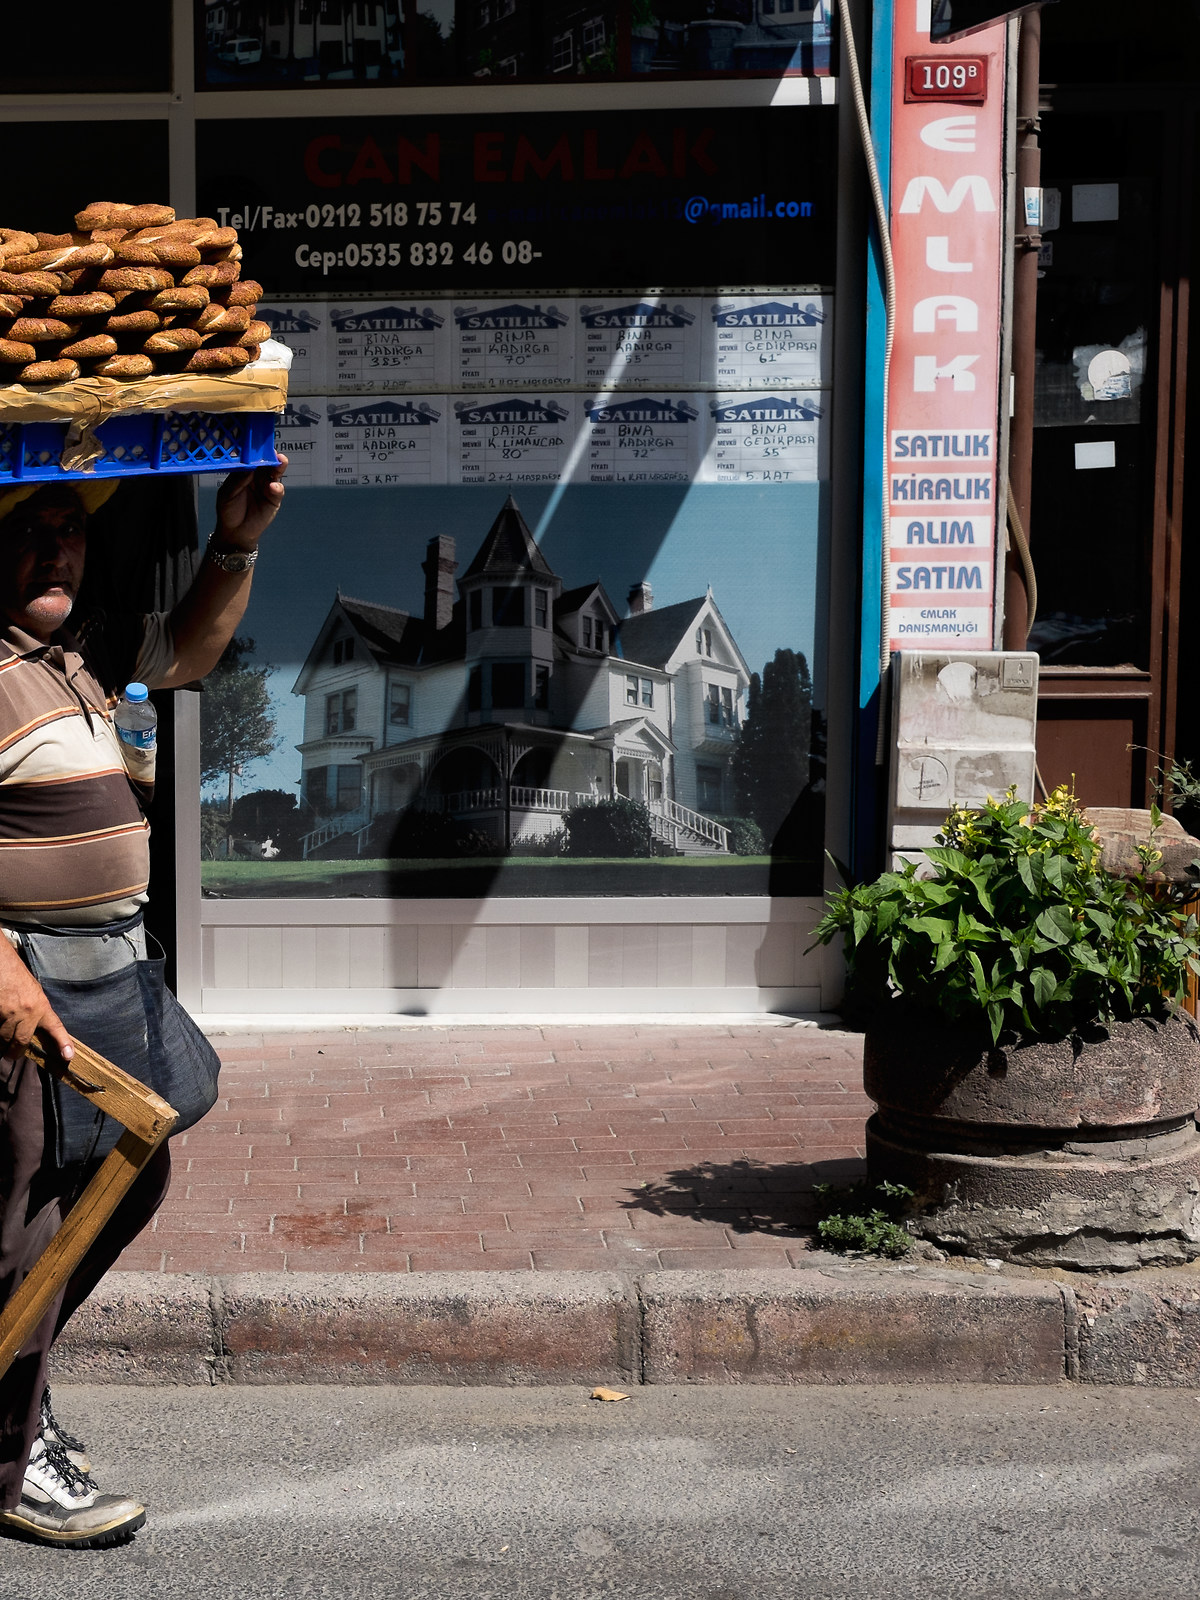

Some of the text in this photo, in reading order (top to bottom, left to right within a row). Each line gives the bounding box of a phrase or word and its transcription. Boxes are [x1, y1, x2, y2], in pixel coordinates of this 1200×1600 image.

[303, 127, 720, 190] CAN EMLAK
[369, 202, 408, 227] 518
[416, 202, 442, 226] 75
[449, 202, 477, 226] 74
[295, 243, 400, 275] Cep:0535
[410, 242, 454, 266] 832
[462, 241, 494, 266] 46
[899, 115, 996, 392] EMLAK
[344, 319, 424, 331] SATILIK
[468, 316, 548, 328] SATILIK
[594, 315, 674, 327] SATILIK
[725, 313, 807, 326] SATILIK
[364, 345, 423, 357] KADIRGA
[489, 344, 550, 355] KADIRGA
[616, 342, 672, 353] KADIRGA
[341, 413, 420, 425] SATILIK
[468, 410, 548, 423] SATILIK
[598, 410, 678, 421] SATILIK
[723, 408, 804, 421] SATILIK
[364, 427, 396, 439] BİNA
[751, 423, 787, 435] BİNA
[362, 440, 417, 451] KADIRGA
[619, 438, 674, 448] KADIRGA
[894, 434, 992, 459] SATILIK
[361, 475, 370, 485] 3
[375, 475, 400, 483] KAT
[763, 471, 793, 481] KAT
[891, 473, 991, 502] KİRALIK
[905, 520, 976, 545] ALIM
[895, 565, 983, 591] SATIM
[919, 609, 958, 620] EMLAK
[897, 621, 979, 637] DANIŞMANLIĞI
